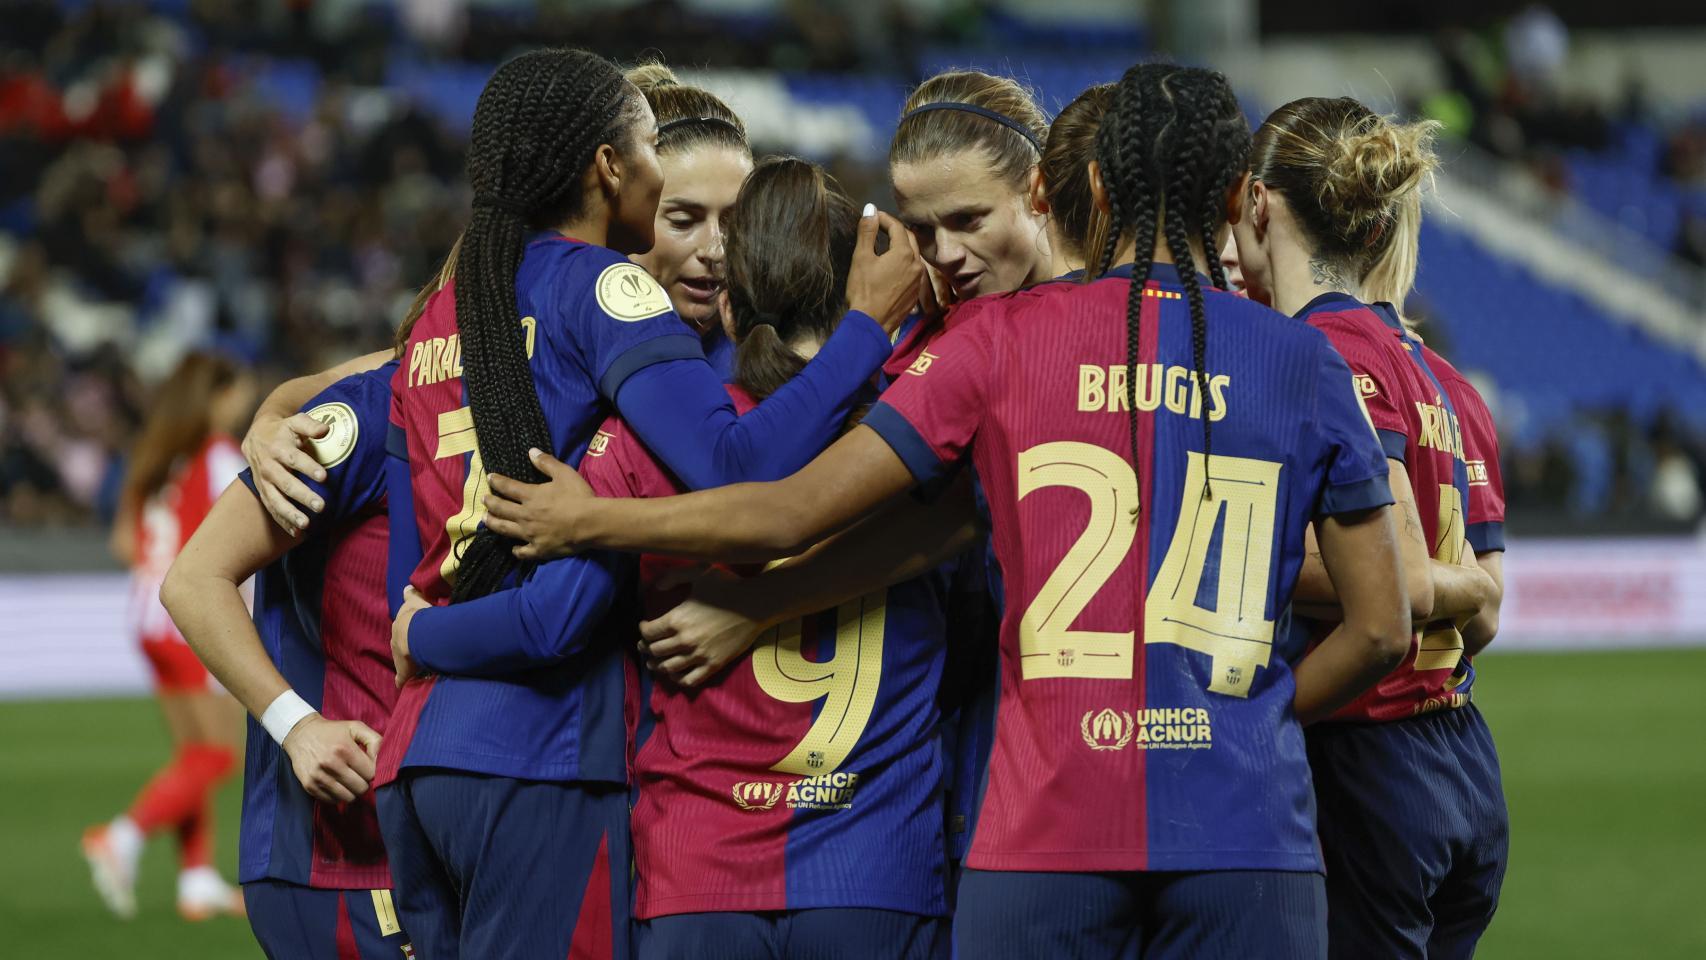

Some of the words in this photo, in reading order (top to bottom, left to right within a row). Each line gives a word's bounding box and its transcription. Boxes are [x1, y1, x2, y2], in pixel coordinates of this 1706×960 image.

[1077, 364, 1230, 421] BRUGTS
[1018, 441, 1283, 698] 24
[752, 557, 887, 776] 9
[1136, 725, 1211, 742] ACNUR
[1137, 708, 1210, 725] UNHCR
